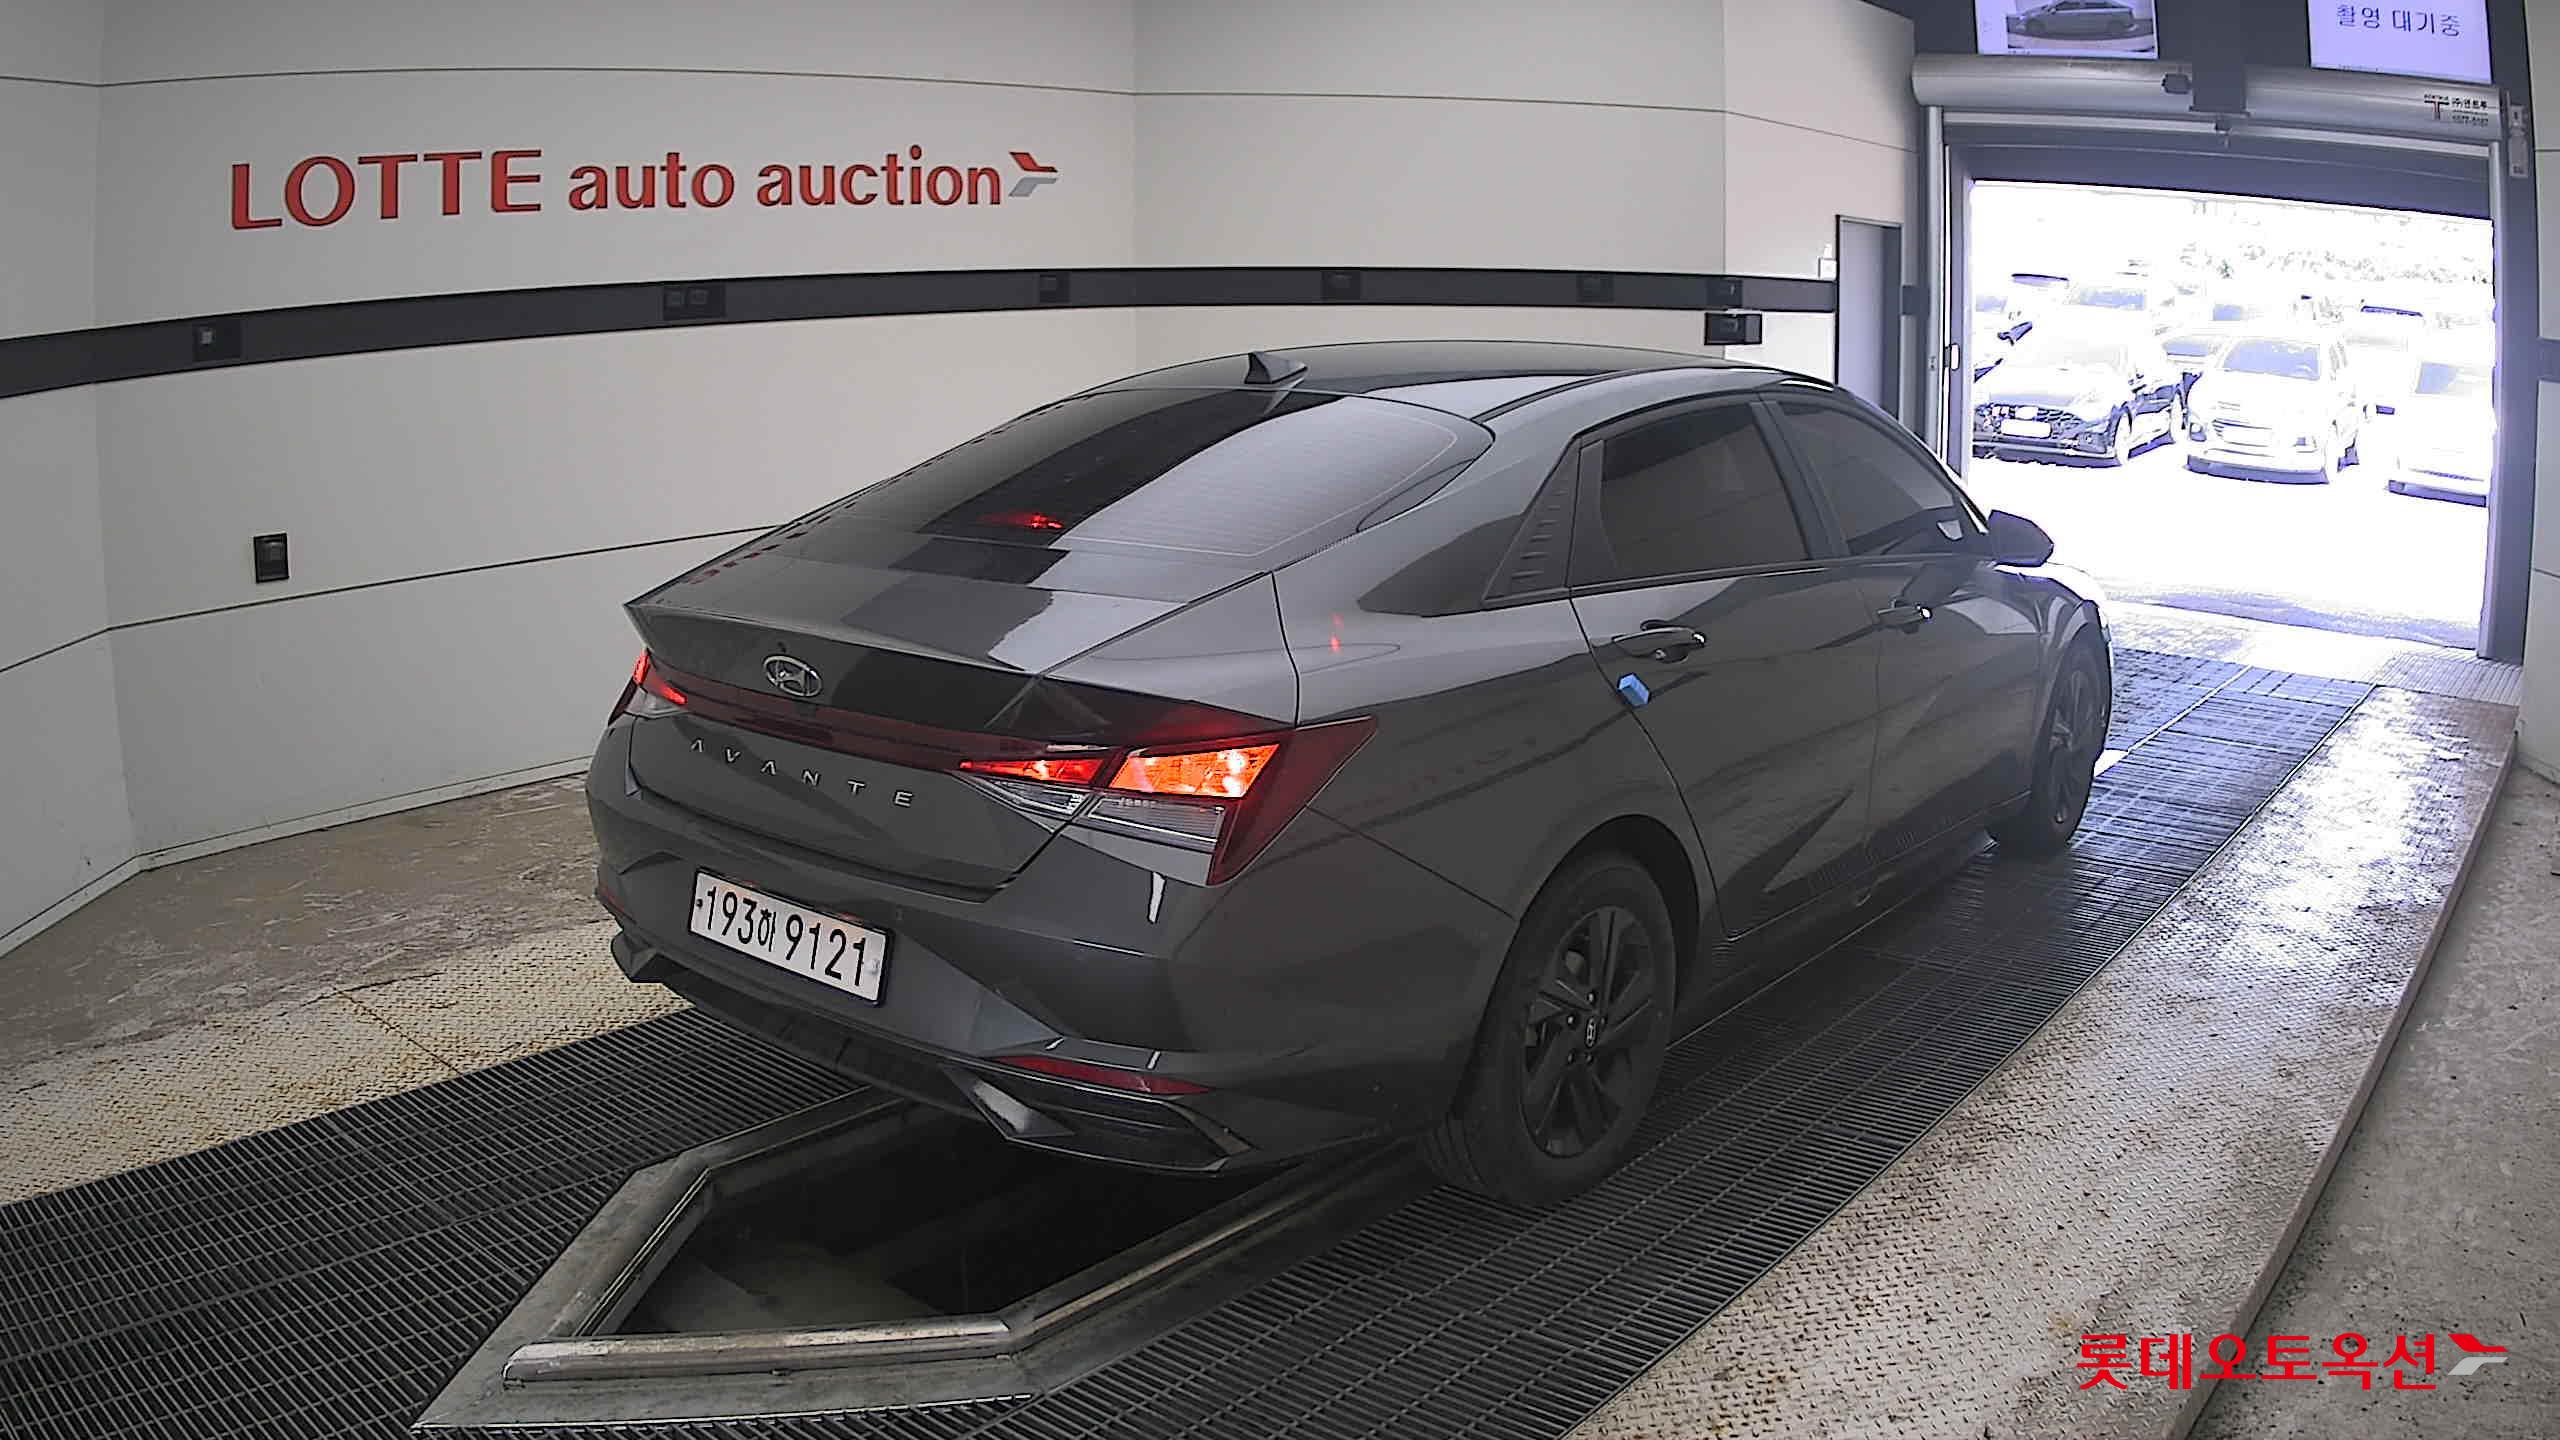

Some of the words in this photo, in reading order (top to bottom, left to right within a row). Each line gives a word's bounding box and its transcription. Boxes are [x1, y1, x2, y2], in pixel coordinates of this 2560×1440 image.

[2337, 4, 2381, 29] 촬영
[2392, 9, 2460, 37] 대기중
[231, 149, 542, 230] LOTTE
[568, 151, 735, 210] auto
[757, 144, 1001, 206] auction
[690, 739, 913, 807] AVANTE
